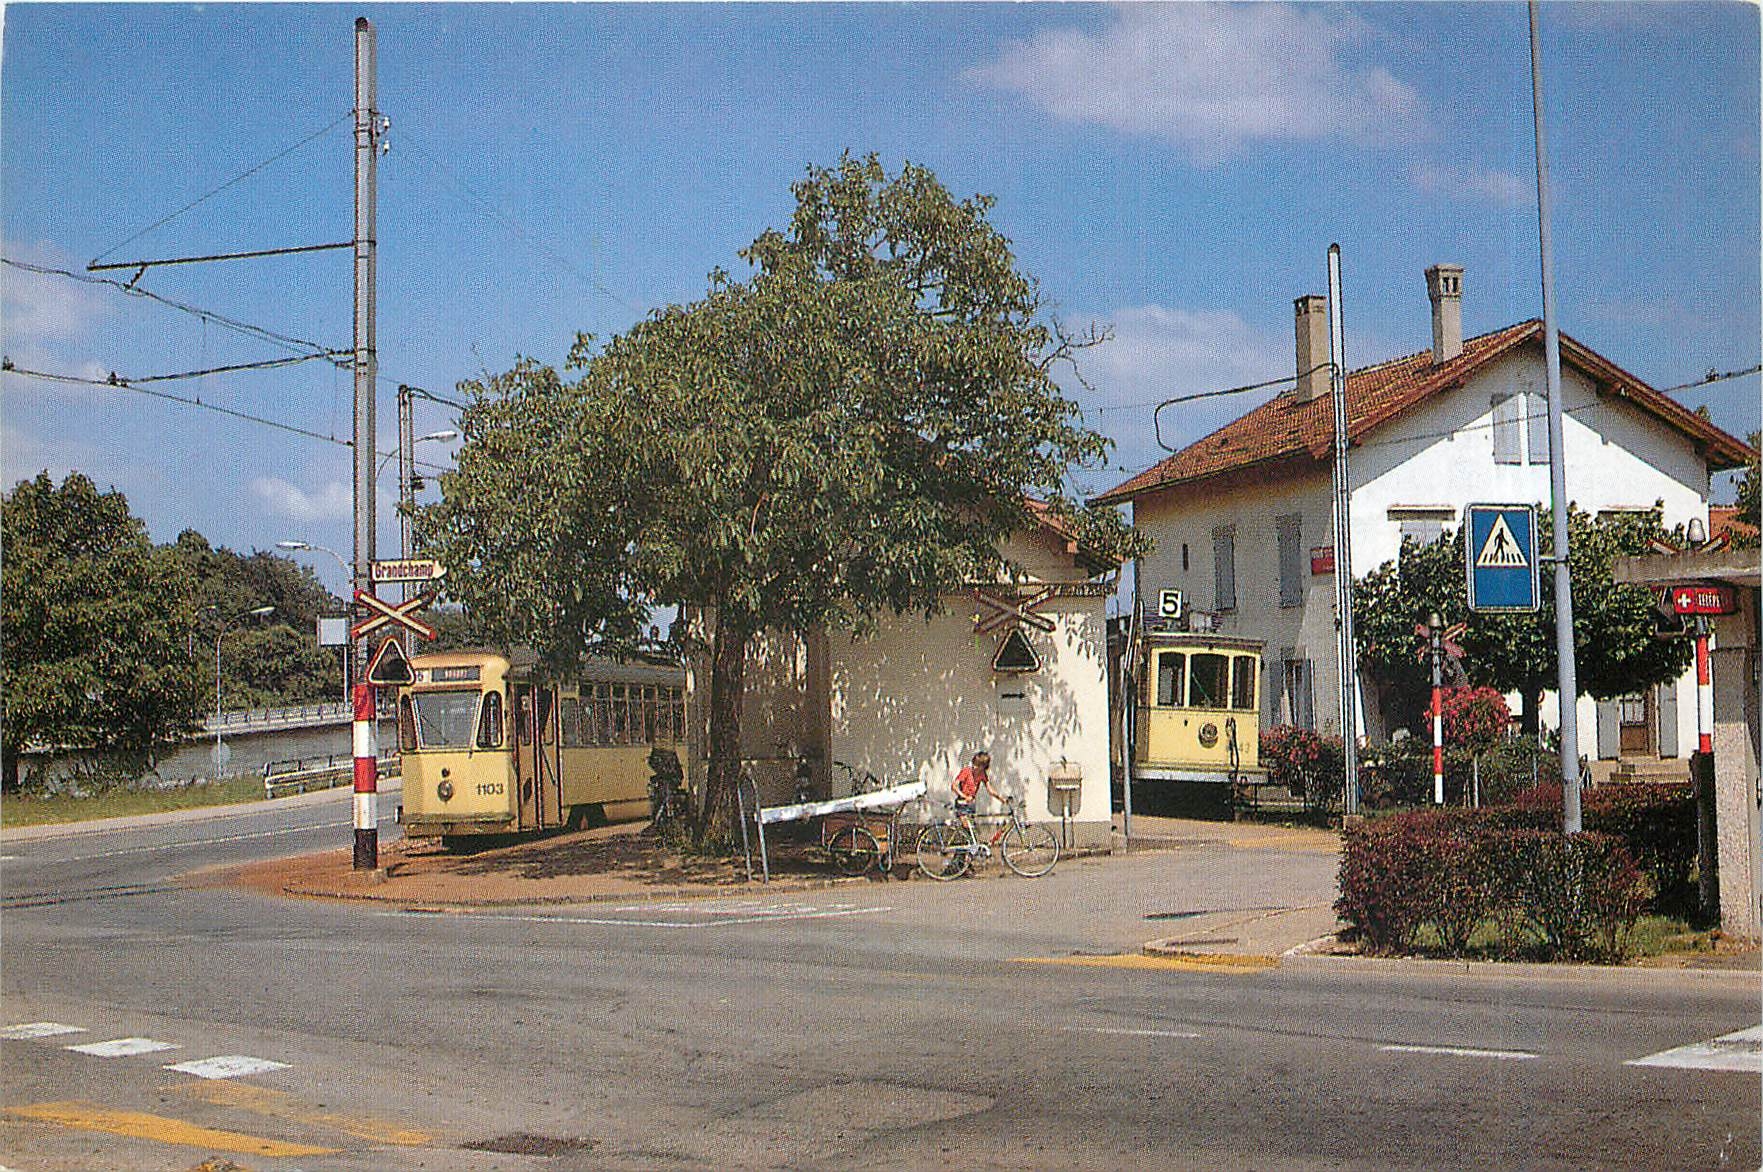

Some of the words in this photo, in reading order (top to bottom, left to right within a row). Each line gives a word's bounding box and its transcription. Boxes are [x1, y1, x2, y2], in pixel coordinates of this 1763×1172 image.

[375, 562, 434, 579] Grandchamp
[1162, 592, 1179, 615] 5
[476, 783, 504, 795] 1103
